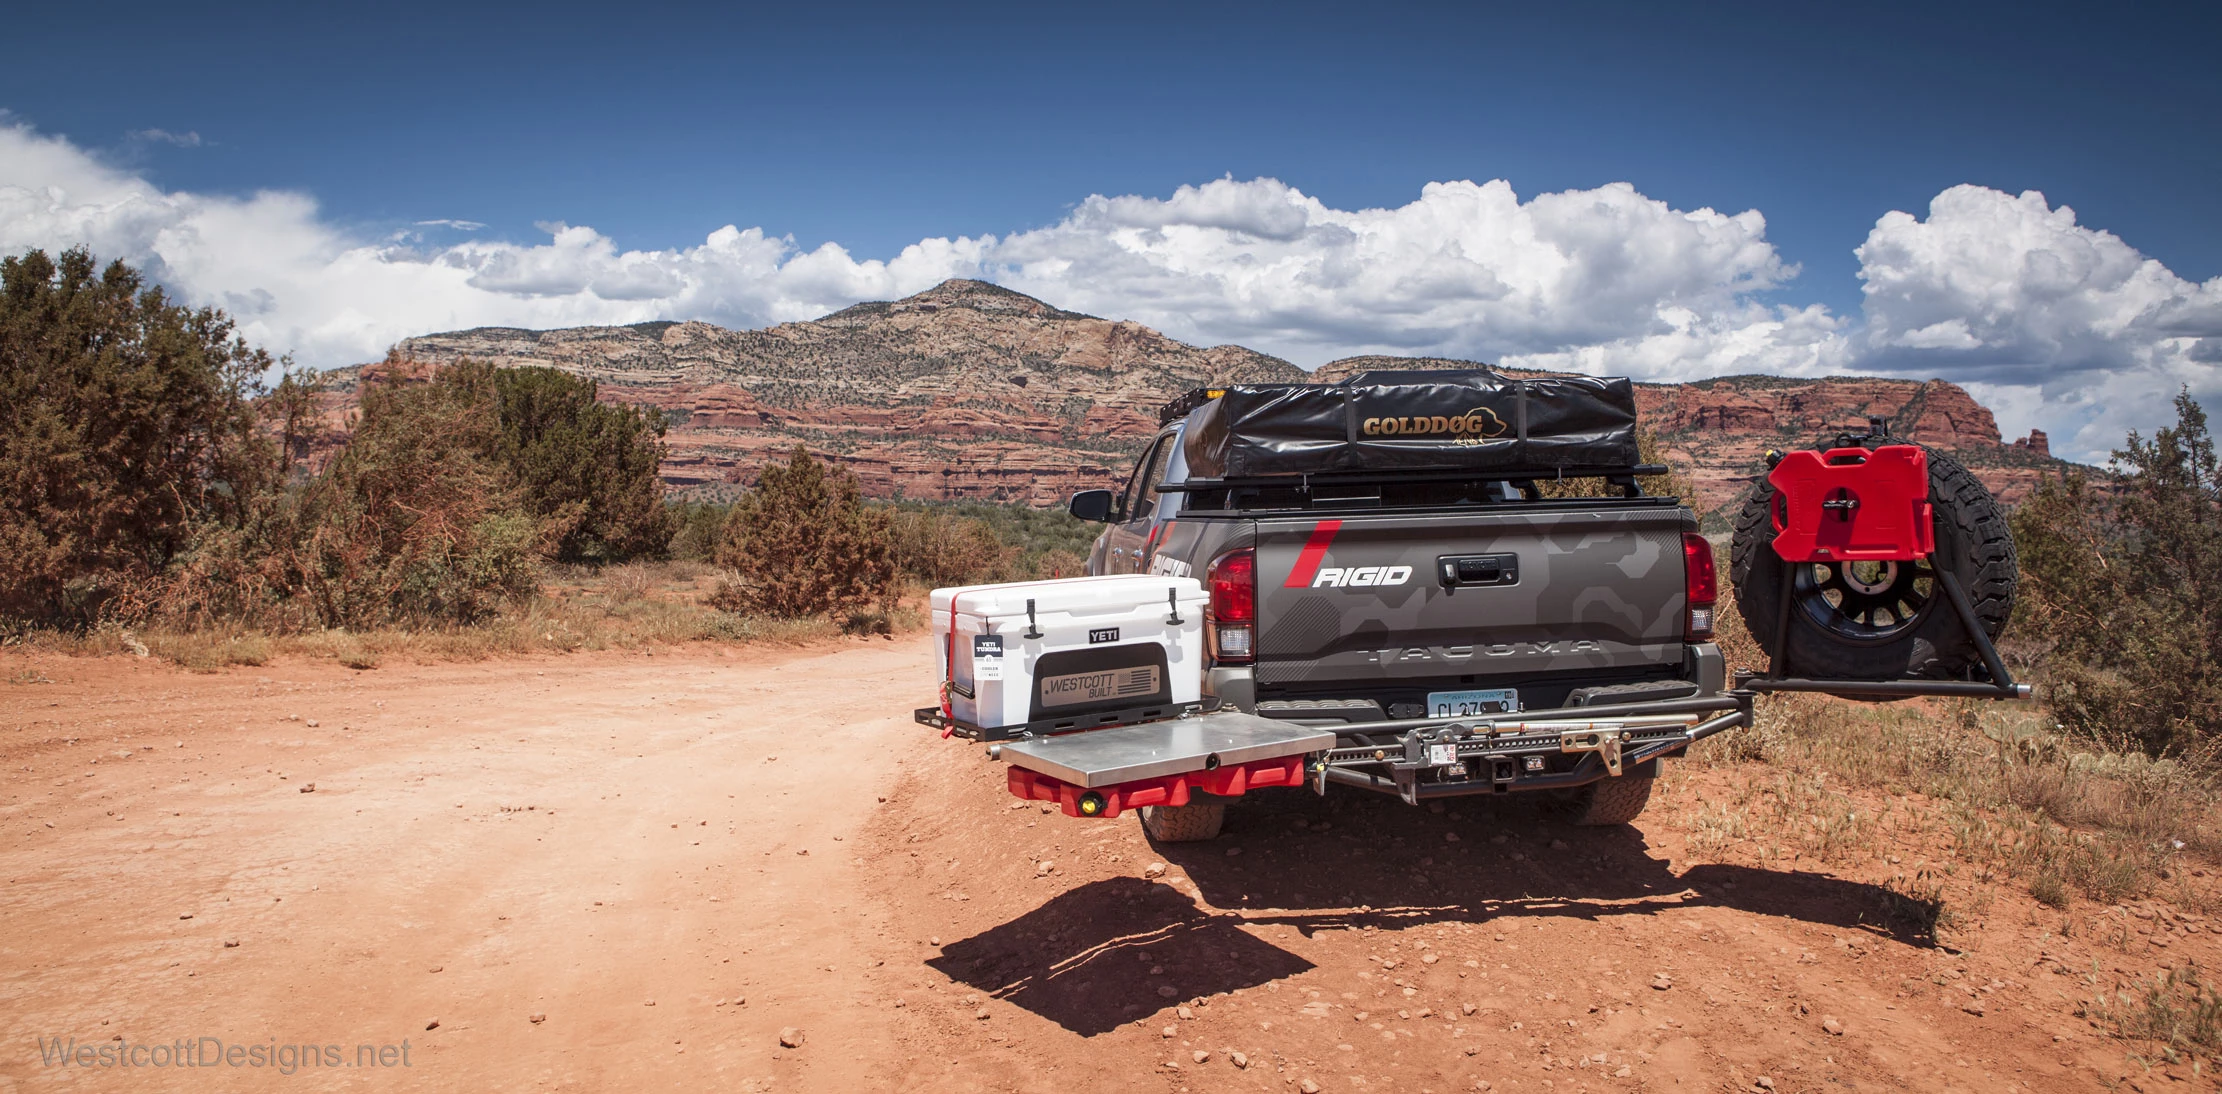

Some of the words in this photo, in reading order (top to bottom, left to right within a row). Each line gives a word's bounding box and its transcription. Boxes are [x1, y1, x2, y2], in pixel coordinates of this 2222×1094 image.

[1312, 565, 1413, 588] RIGID
[1090, 630, 1118, 642] YETI
[1356, 640, 1600, 661] TACOMA
[1050, 673, 1115, 693] WESTCOTT
[1088, 686, 1112, 698] BUILT
